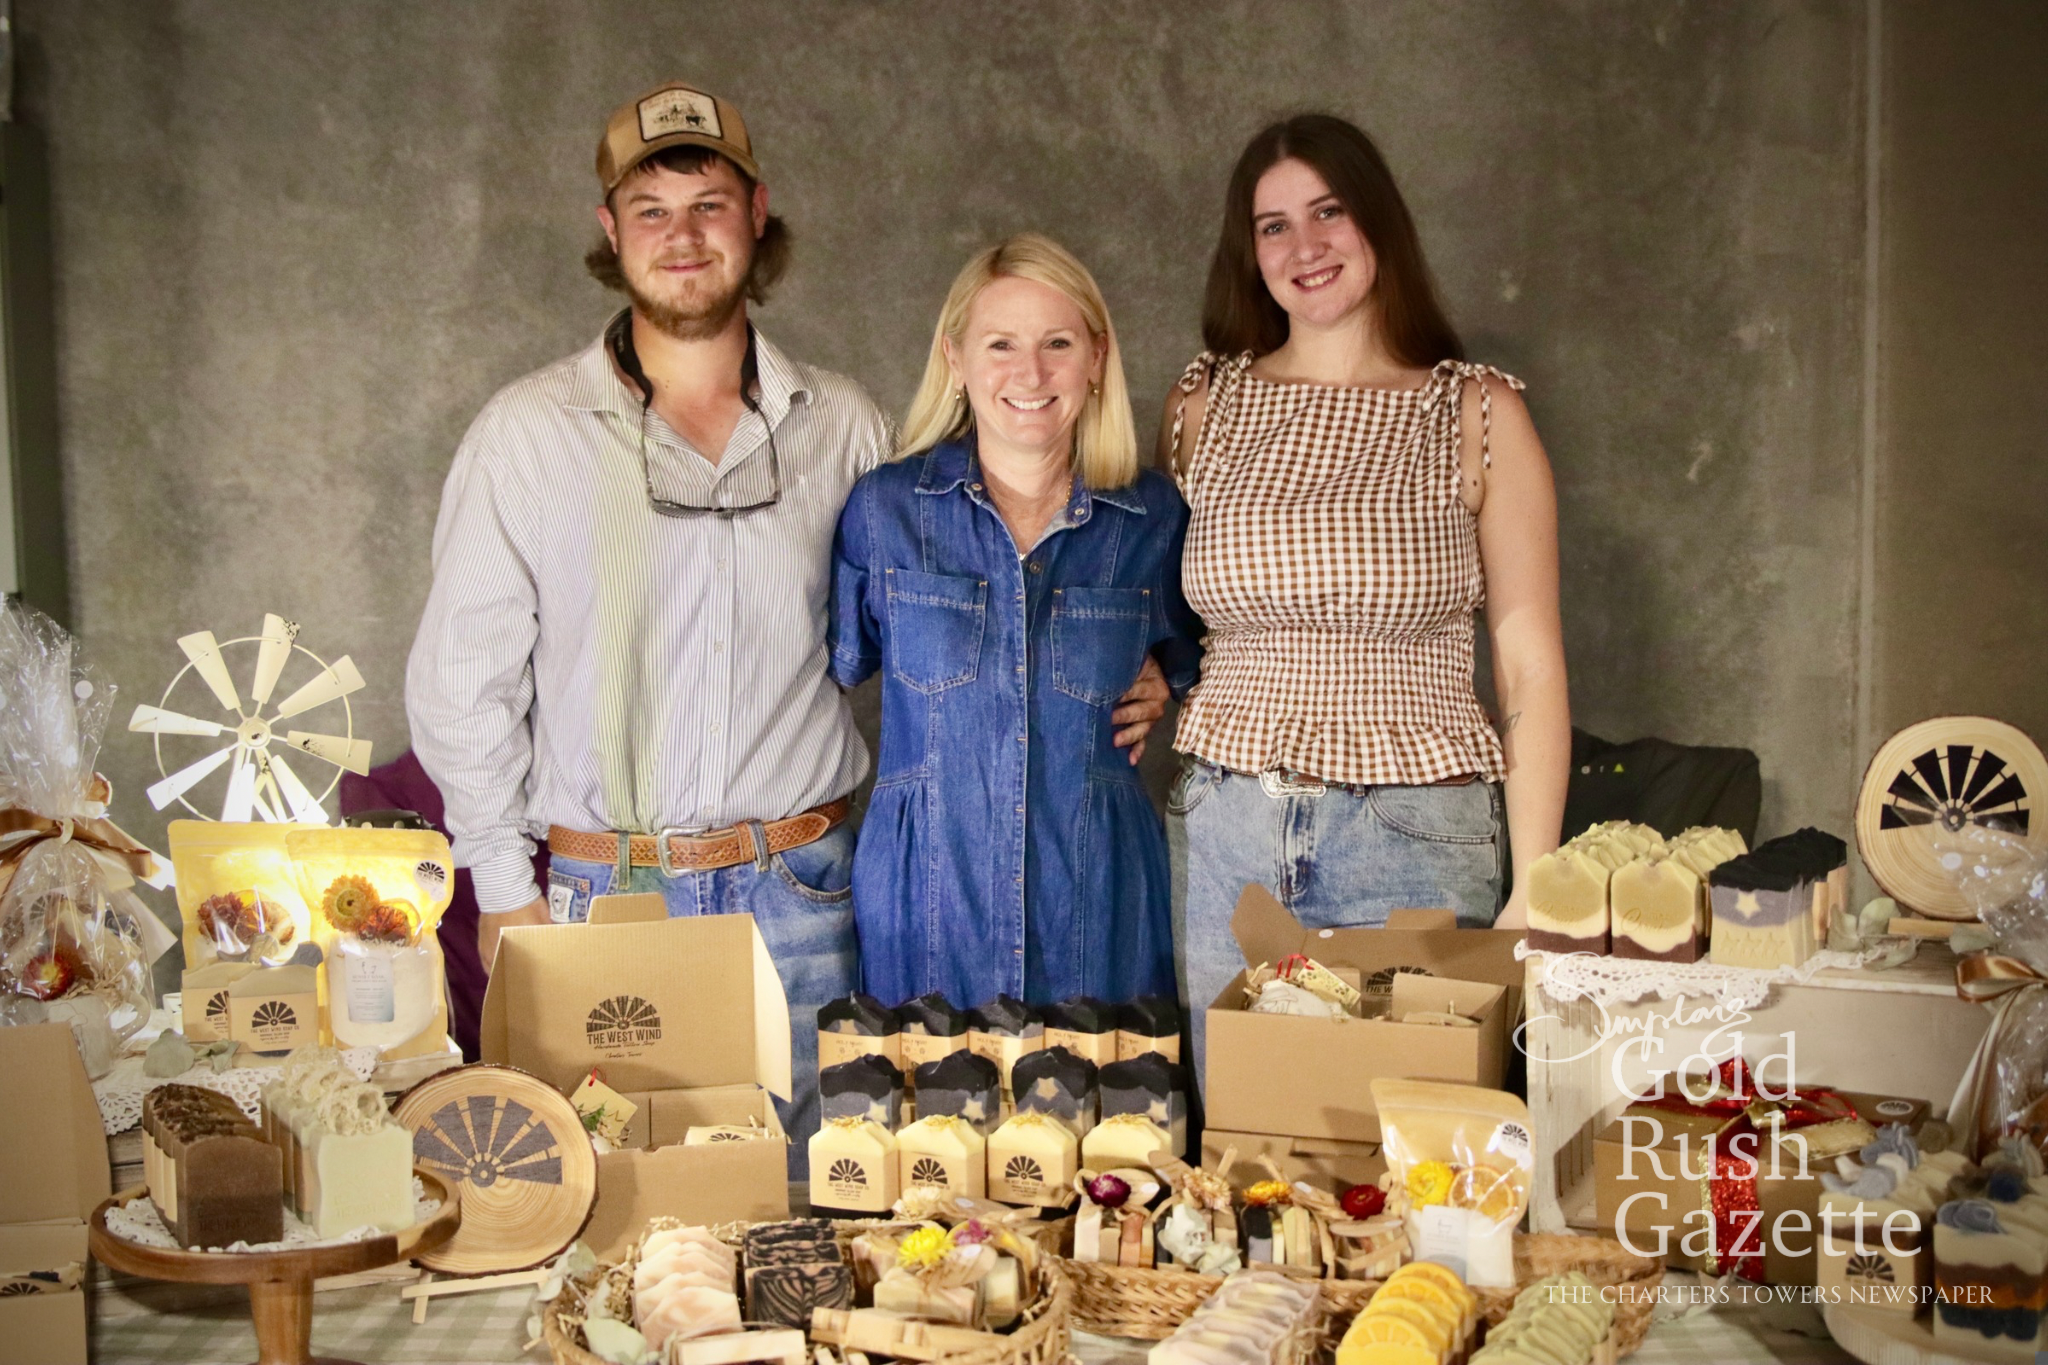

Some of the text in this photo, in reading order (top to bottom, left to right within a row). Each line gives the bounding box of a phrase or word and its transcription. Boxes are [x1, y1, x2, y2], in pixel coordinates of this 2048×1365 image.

[587, 1028, 662, 1045] THE WEST WIND
